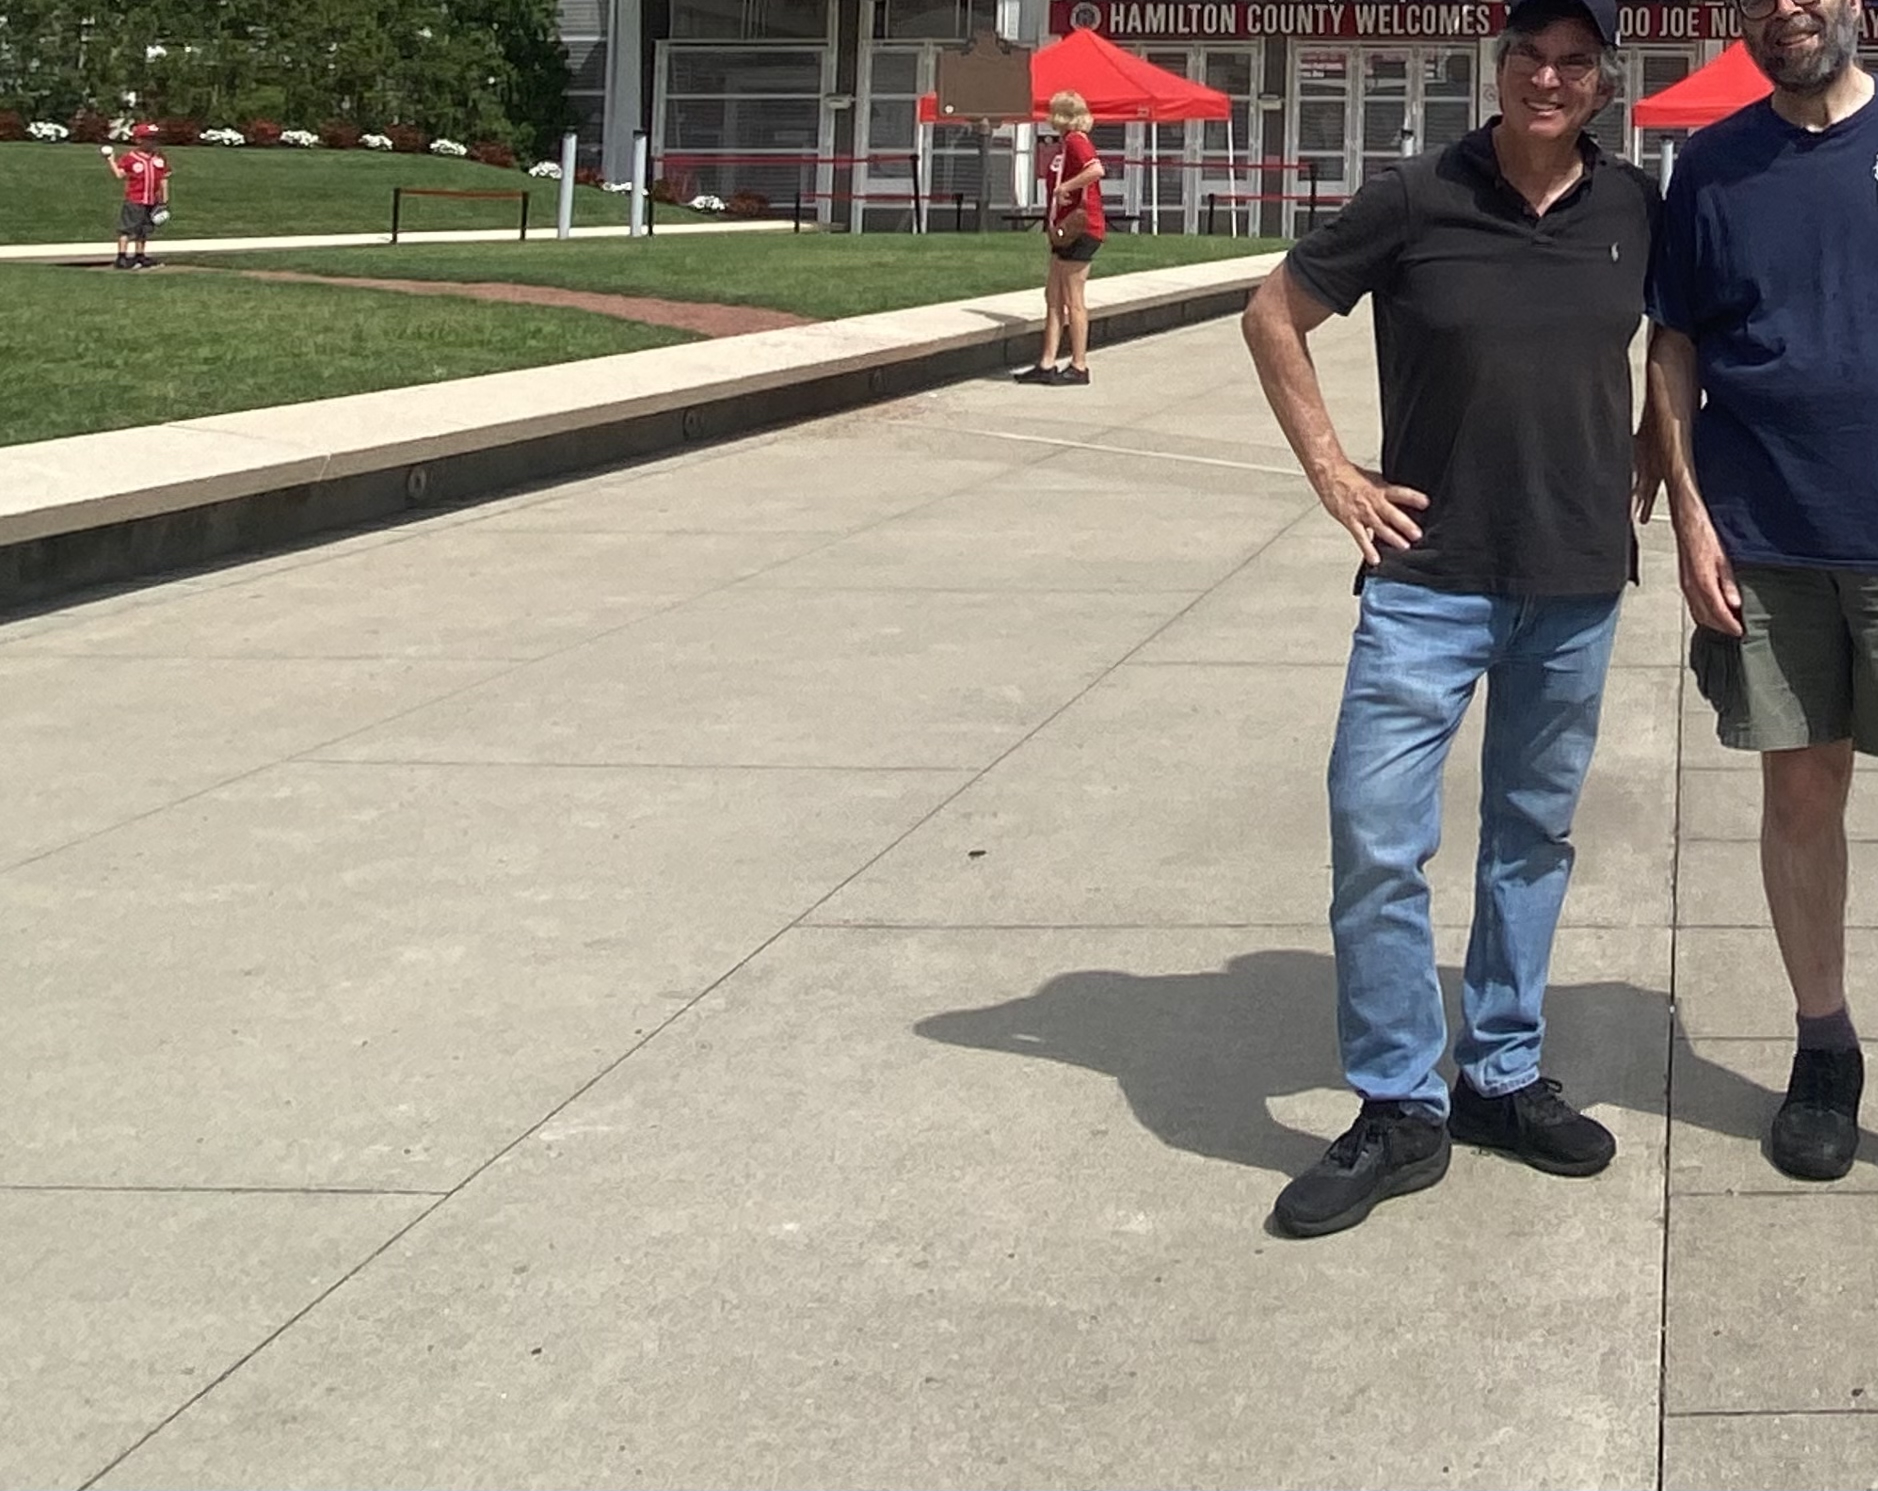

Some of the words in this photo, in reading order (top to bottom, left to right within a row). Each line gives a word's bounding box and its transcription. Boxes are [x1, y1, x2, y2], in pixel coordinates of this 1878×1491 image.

[1109, 2, 1236, 34] HAMILTON
[1247, 3, 1345, 35] COUNTY
[1354, 4, 1491, 35] WELCOMES
[1658, 7, 1700, 38] JOE
